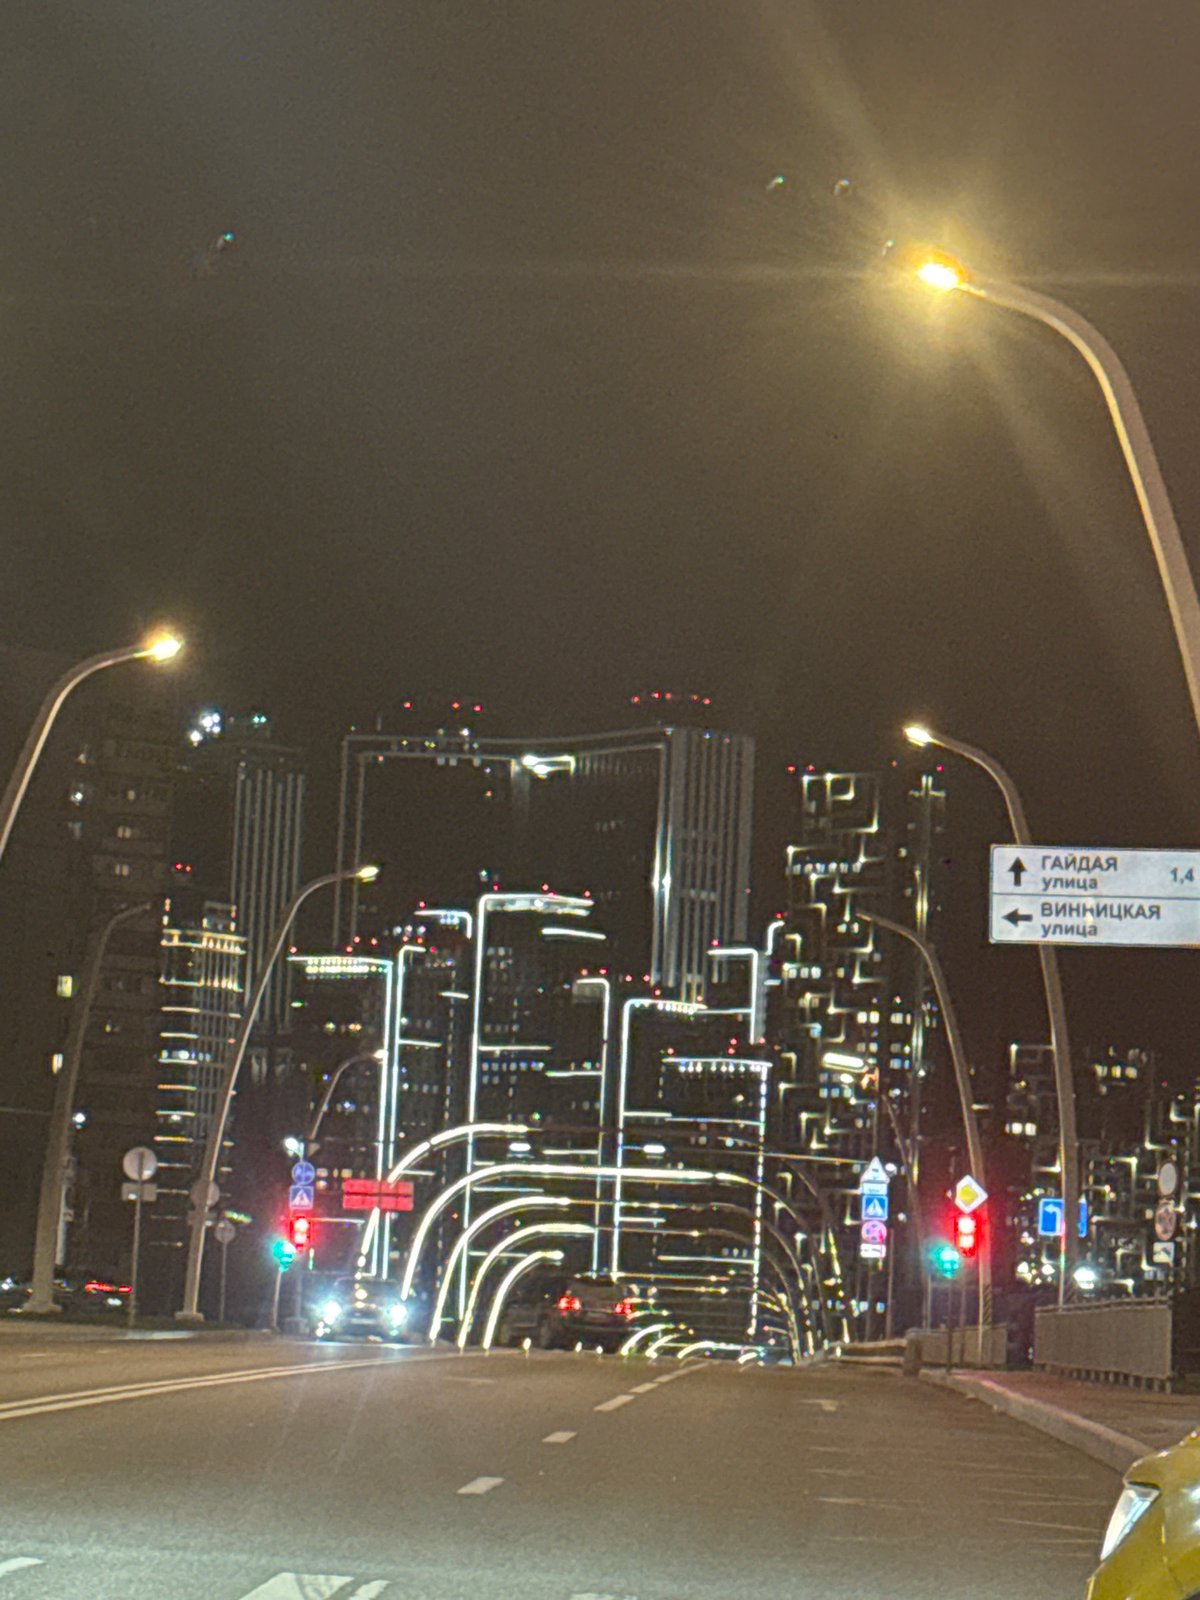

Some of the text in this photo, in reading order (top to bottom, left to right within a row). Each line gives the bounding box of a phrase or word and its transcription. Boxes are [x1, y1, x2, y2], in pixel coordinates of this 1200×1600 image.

[1041, 853, 1118, 872] ГАЙДАЯ
[1042, 876, 1098, 890] улица
[1170, 867, 1195, 884] 1,4
[1041, 902, 1161, 920] ВИННИЦКАЯ
[1041, 924, 1098, 938] улица
